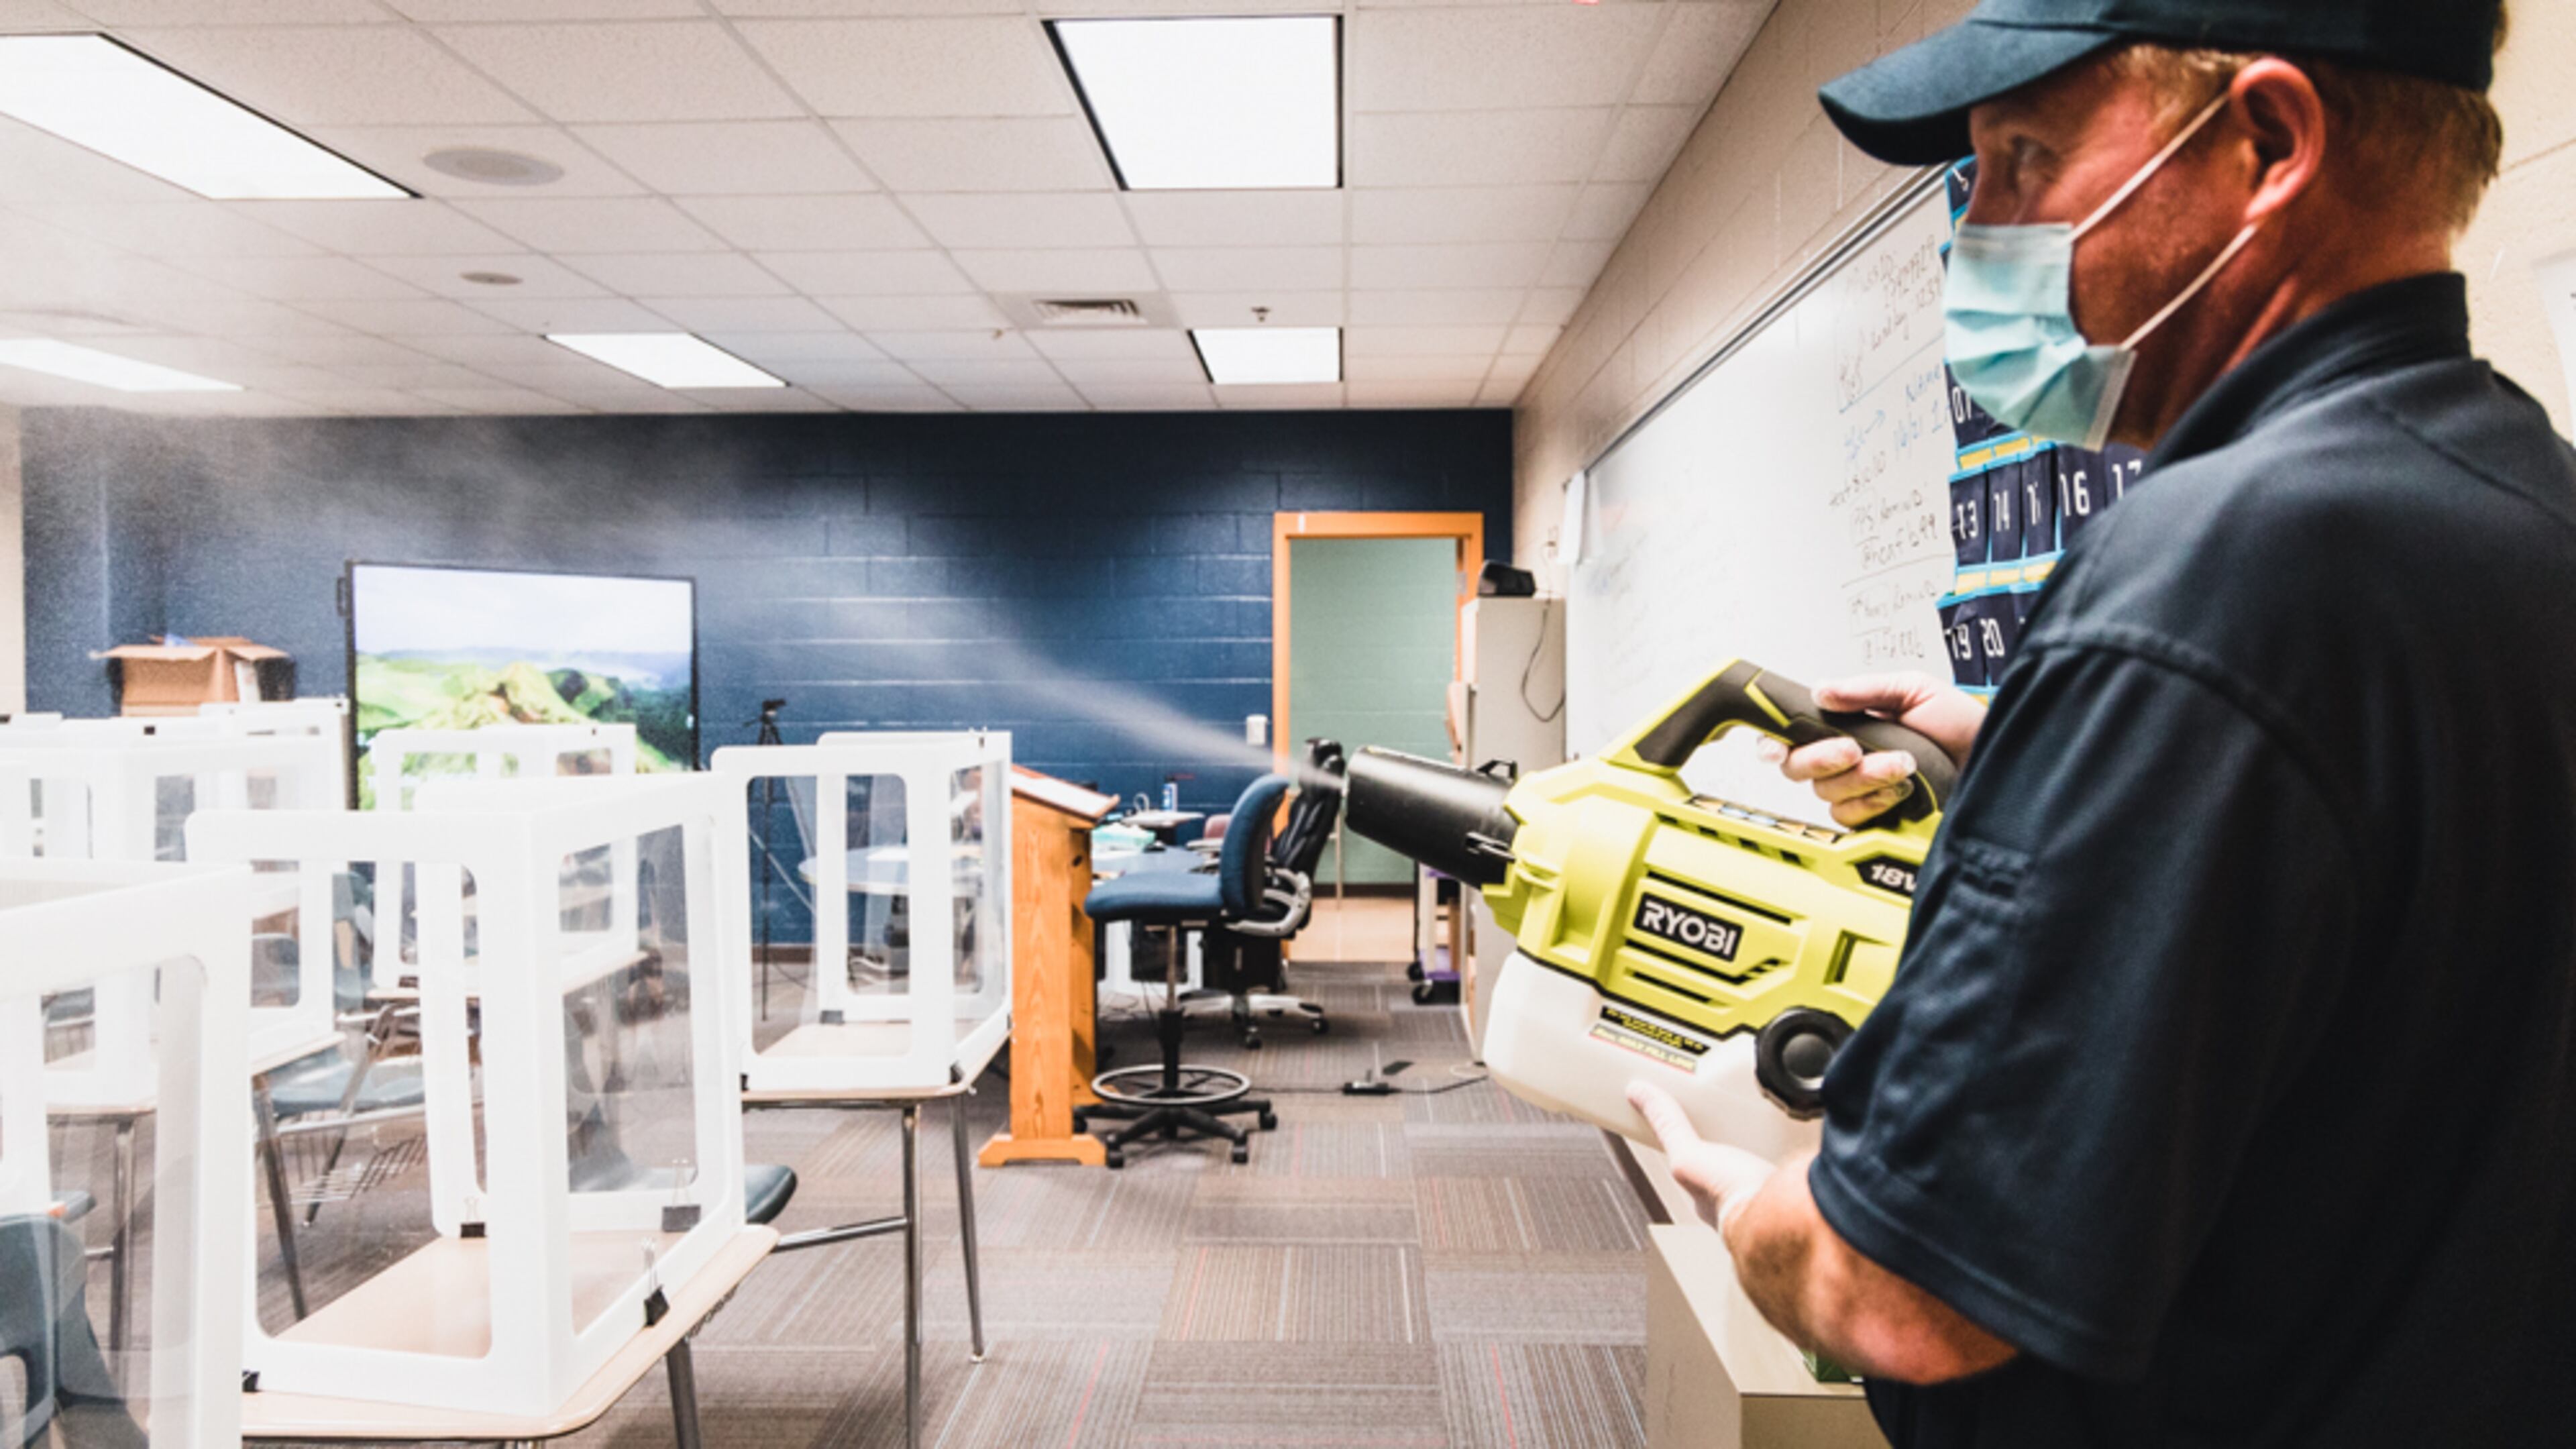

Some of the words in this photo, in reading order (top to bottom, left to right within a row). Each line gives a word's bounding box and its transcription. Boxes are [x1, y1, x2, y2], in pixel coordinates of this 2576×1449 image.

[1994, 490, 2010, 532] 14
[2059, 470, 2091, 517] 16
[1957, 499, 1979, 539] 13
[1945, 623, 1972, 661] 19
[1979, 617, 2005, 658] 20
[1642, 900, 1737, 956] RYOBI
